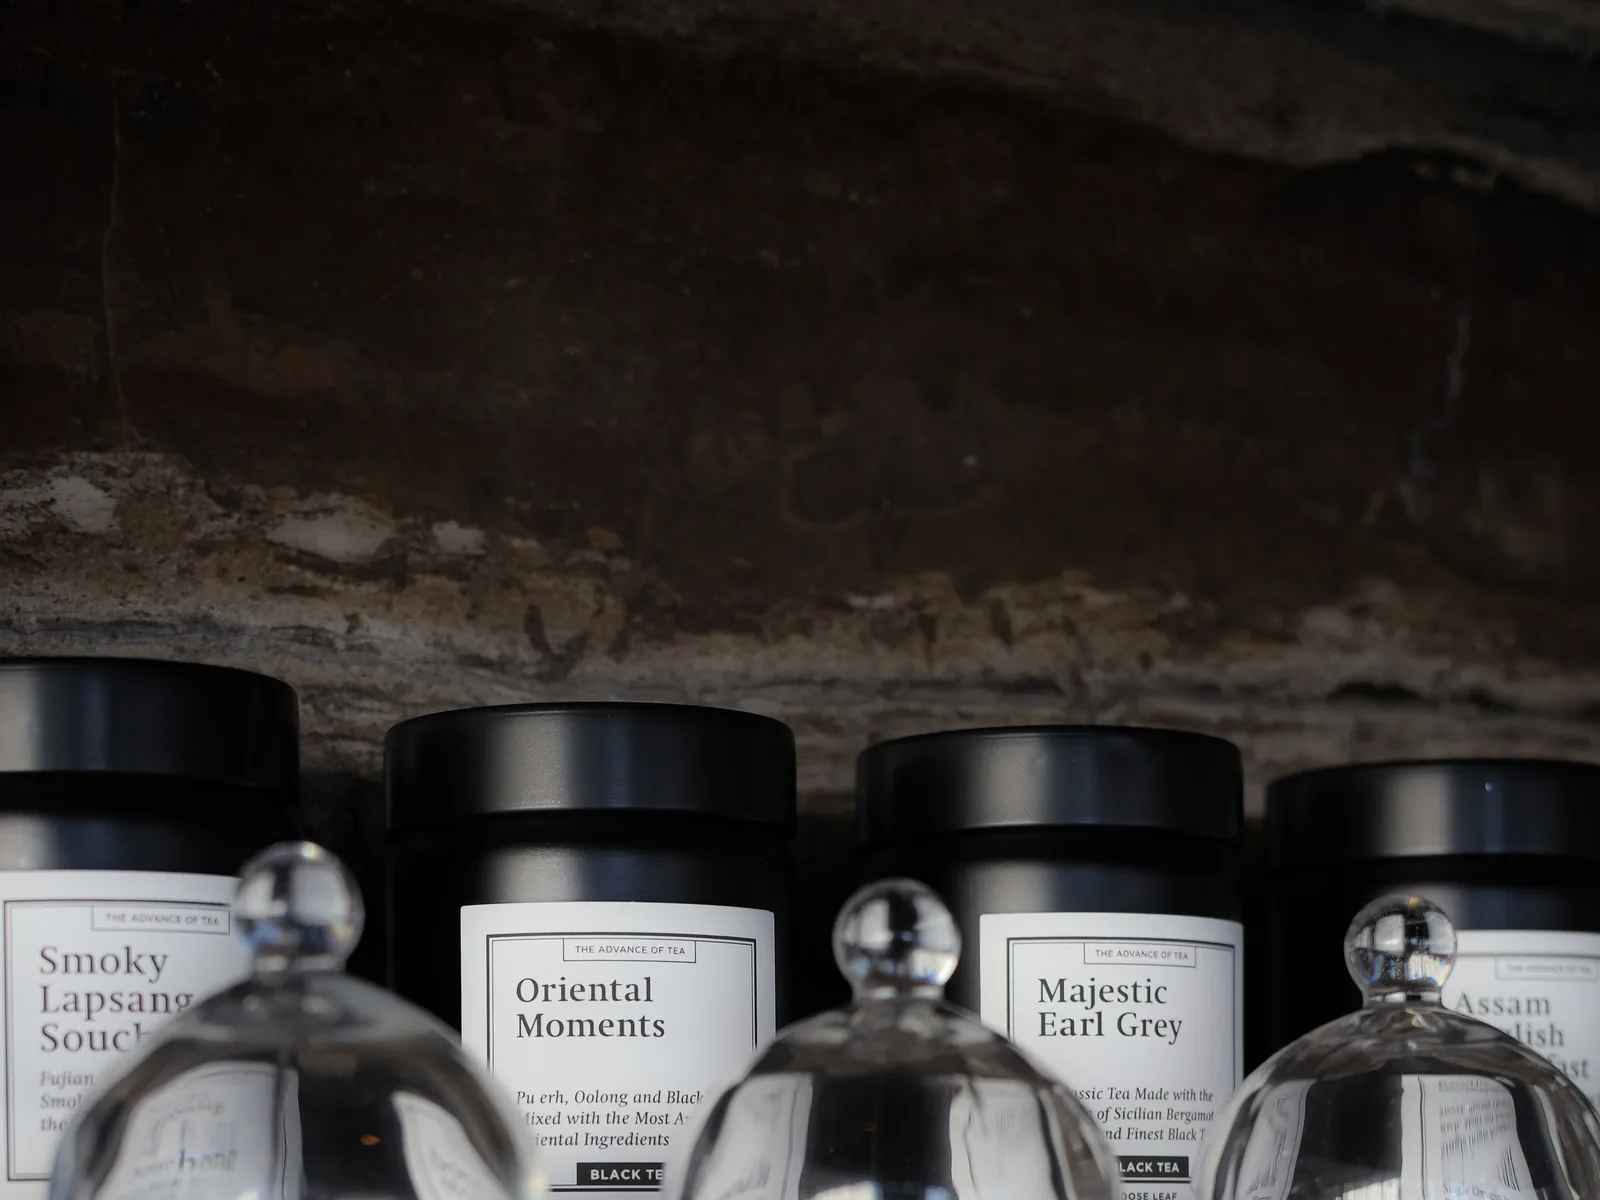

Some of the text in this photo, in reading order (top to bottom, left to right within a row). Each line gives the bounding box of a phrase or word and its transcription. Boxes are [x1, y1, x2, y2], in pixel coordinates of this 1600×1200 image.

[575, 944, 686, 956] THE ADVANCE OF TEA
[1096, 949, 1189, 961] THE ADVANCE OF TEA
[40, 945, 169, 984] Smoky
[516, 976, 654, 1003] Oriental
[1038, 977, 1167, 1010] Majestic
[40, 984, 194, 1022] Lapsang
[1455, 992, 1550, 1016] Assam
[516, 1013, 666, 1039] Moments
[1038, 1011, 1183, 1045] Earl Grey
[540, 1089, 569, 1106] erh,
[574, 1089, 628, 1107] Oolong
[633, 1089, 661, 1105] and
[1107, 1087, 1130, 1100] Tea
[1135, 1087, 1170, 1101] Made
[1173, 1088, 1196, 1102] with
[1199, 1088, 1213, 1102] the
[567, 1110, 600, 1125] with
[606, 1110, 630, 1125] the
[635, 1111, 671, 1125] Most
[1096, 1106, 1112, 1124] of
[1113, 1107, 1162, 1121] Sicilian
[584, 1131, 670, 1150] Ingredients
[1126, 1127, 1164, 1141] Finest
[1168, 1127, 1197, 1141] Black
[590, 1168, 664, 1181] BLACK TE
[1119, 1161, 1180, 1173] LACK TEA
[1152, 1192, 1177, 1200] LEAF
